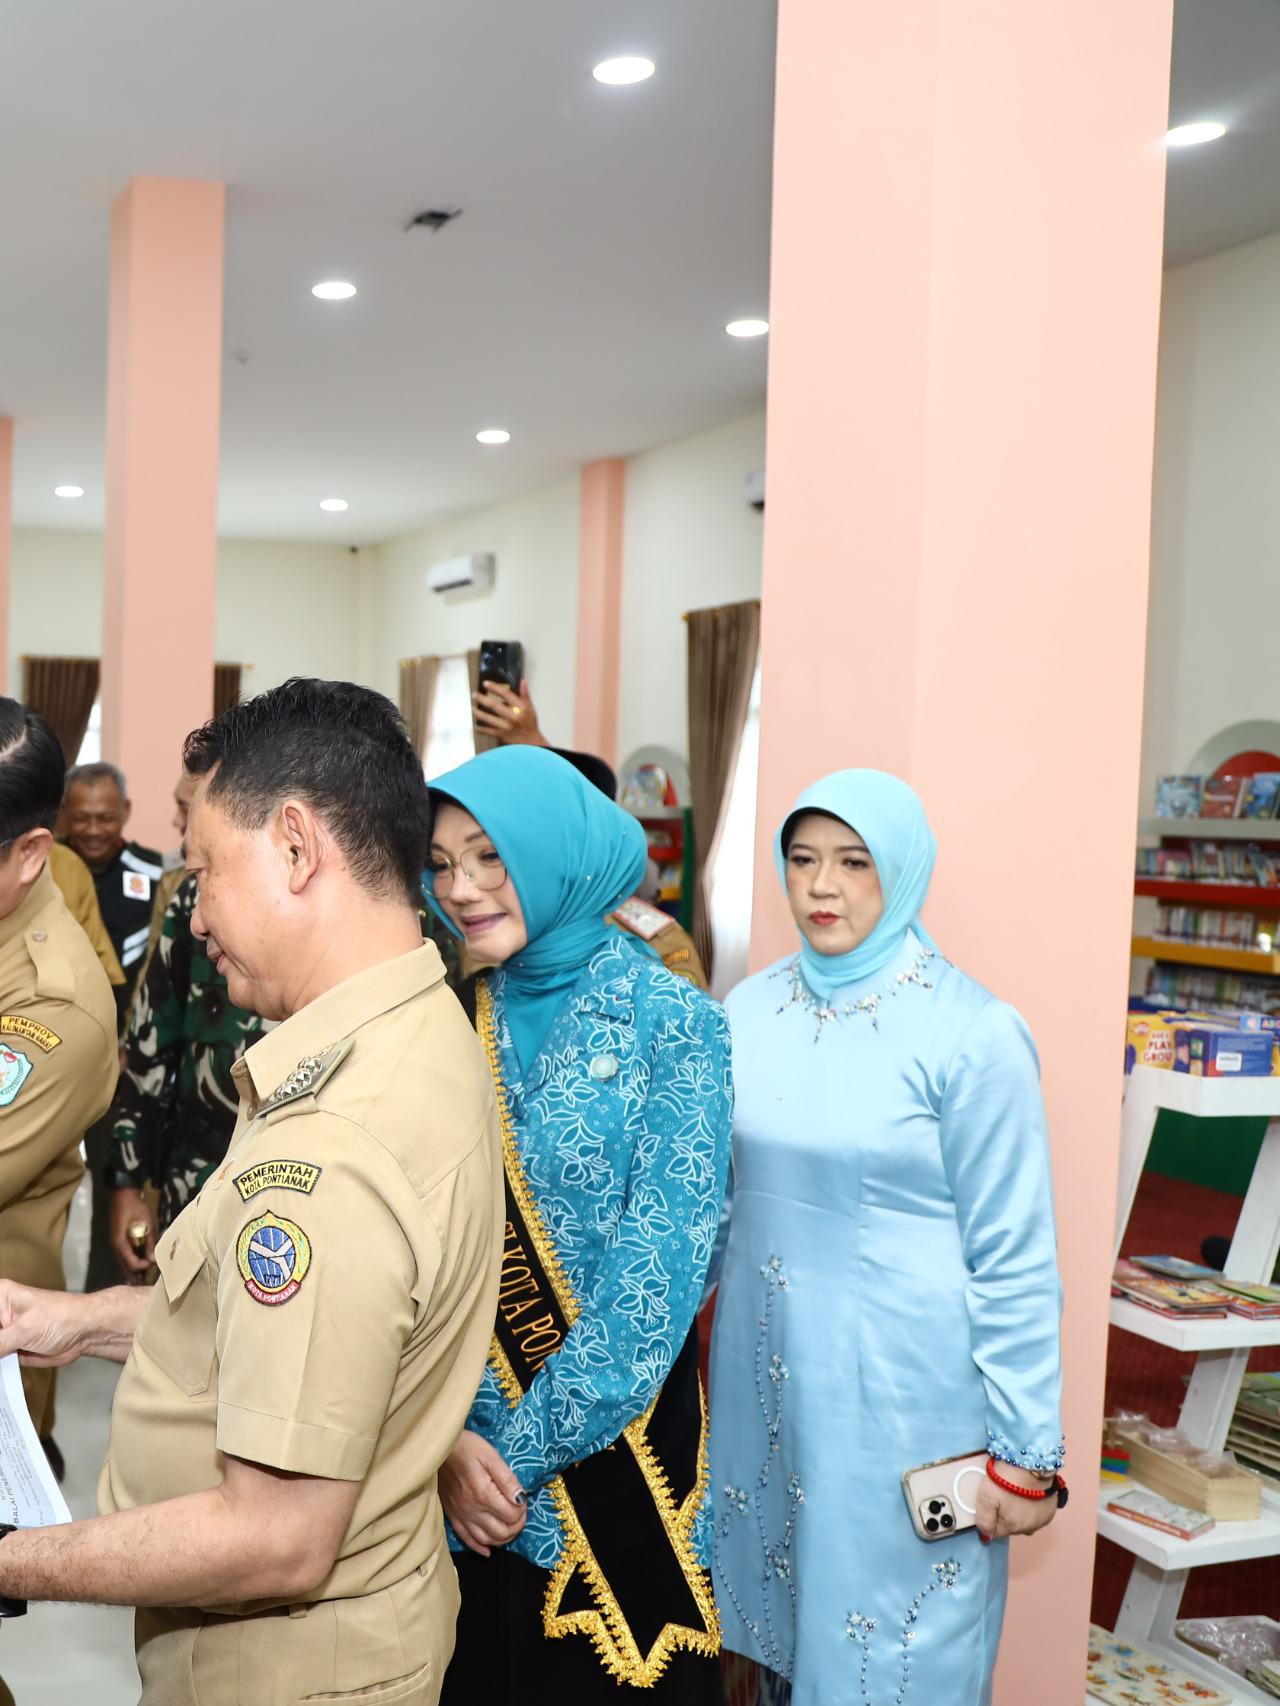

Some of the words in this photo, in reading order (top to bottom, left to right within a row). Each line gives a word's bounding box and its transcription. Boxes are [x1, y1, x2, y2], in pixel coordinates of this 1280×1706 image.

[2, 1024, 35, 1039] KALIMANTAN
[36, 1035, 52, 1049] BARAT
[9, 1018, 54, 1039] PEMPROV
[240, 1164, 313, 1186] PEMERINTAH
[244, 1180, 261, 1196] KOTA
[263, 1174, 311, 1190] PONTIANAK
[247, 1282, 263, 1299] KOTA
[263, 1283, 297, 1303] PONTIANAK
[8, 1496, 20, 1524] BALAI
